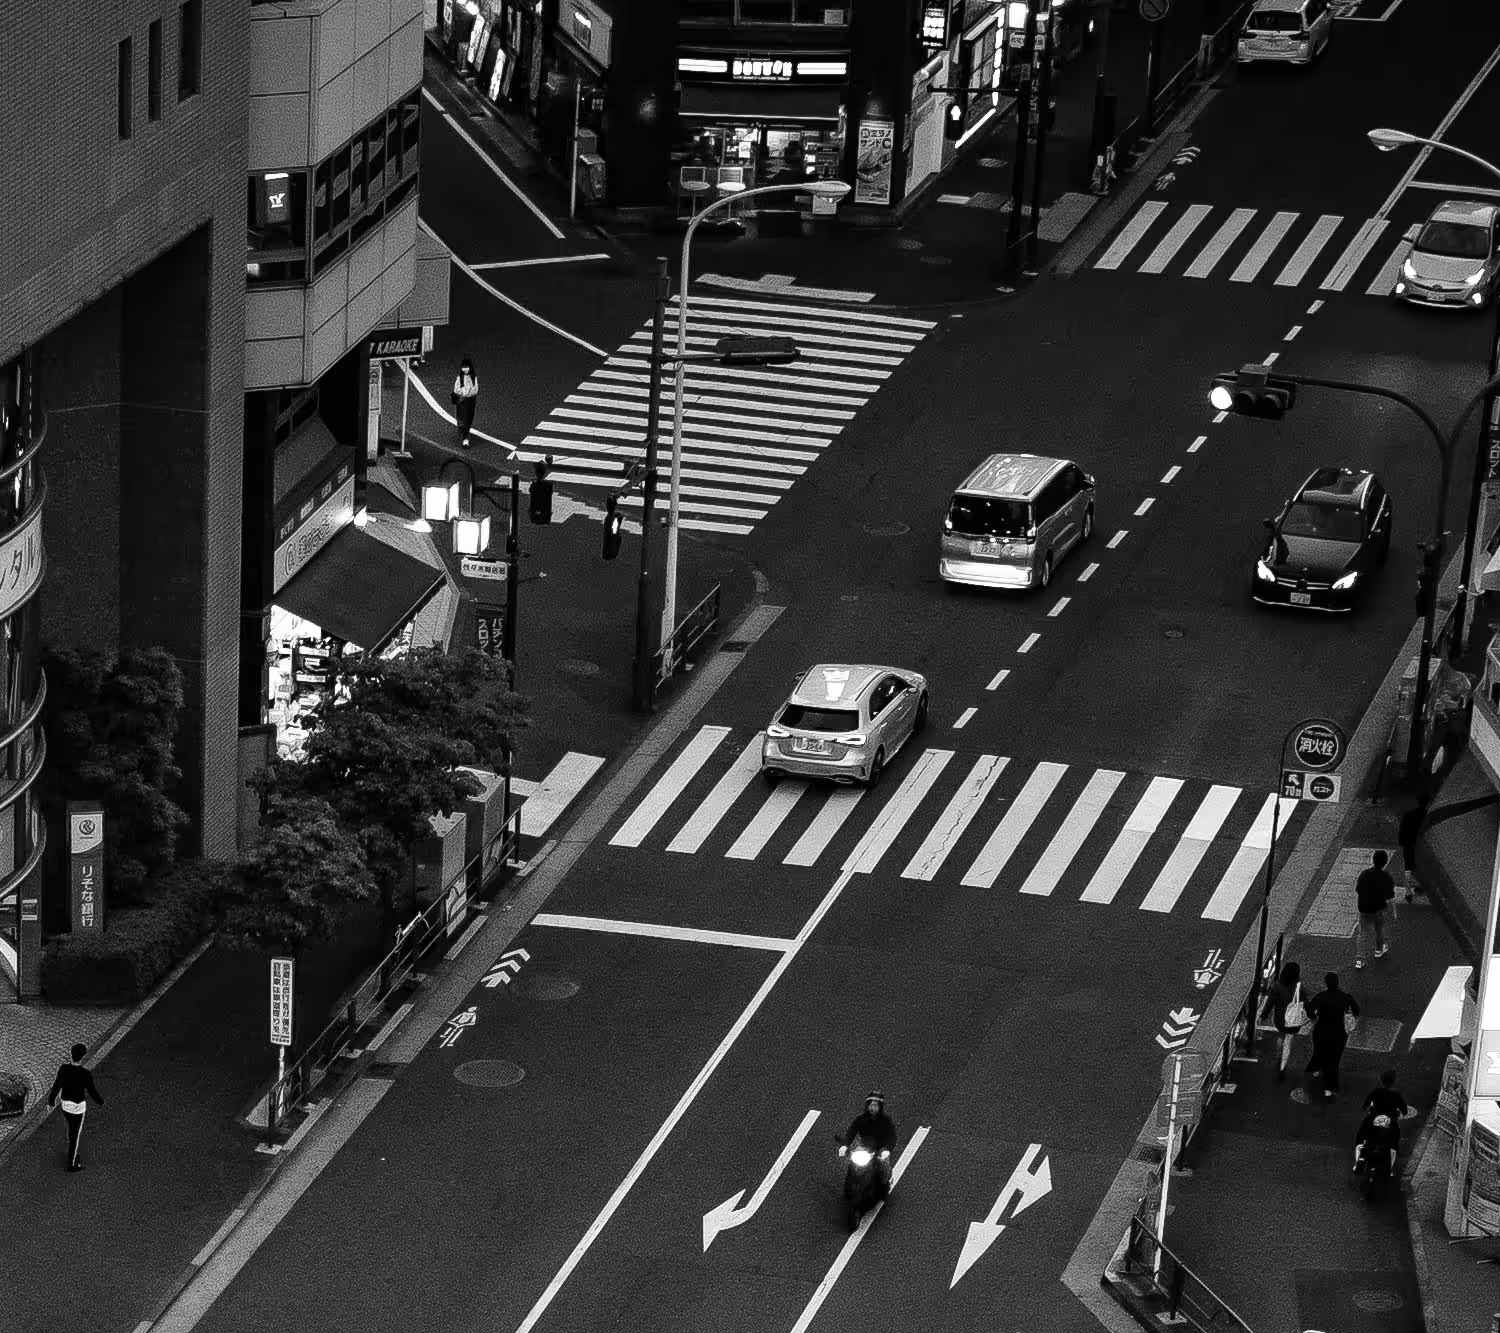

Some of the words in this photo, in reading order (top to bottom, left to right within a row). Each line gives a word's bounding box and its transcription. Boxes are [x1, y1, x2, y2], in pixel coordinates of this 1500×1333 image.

[80, 865, 94, 927] りそな銀行
